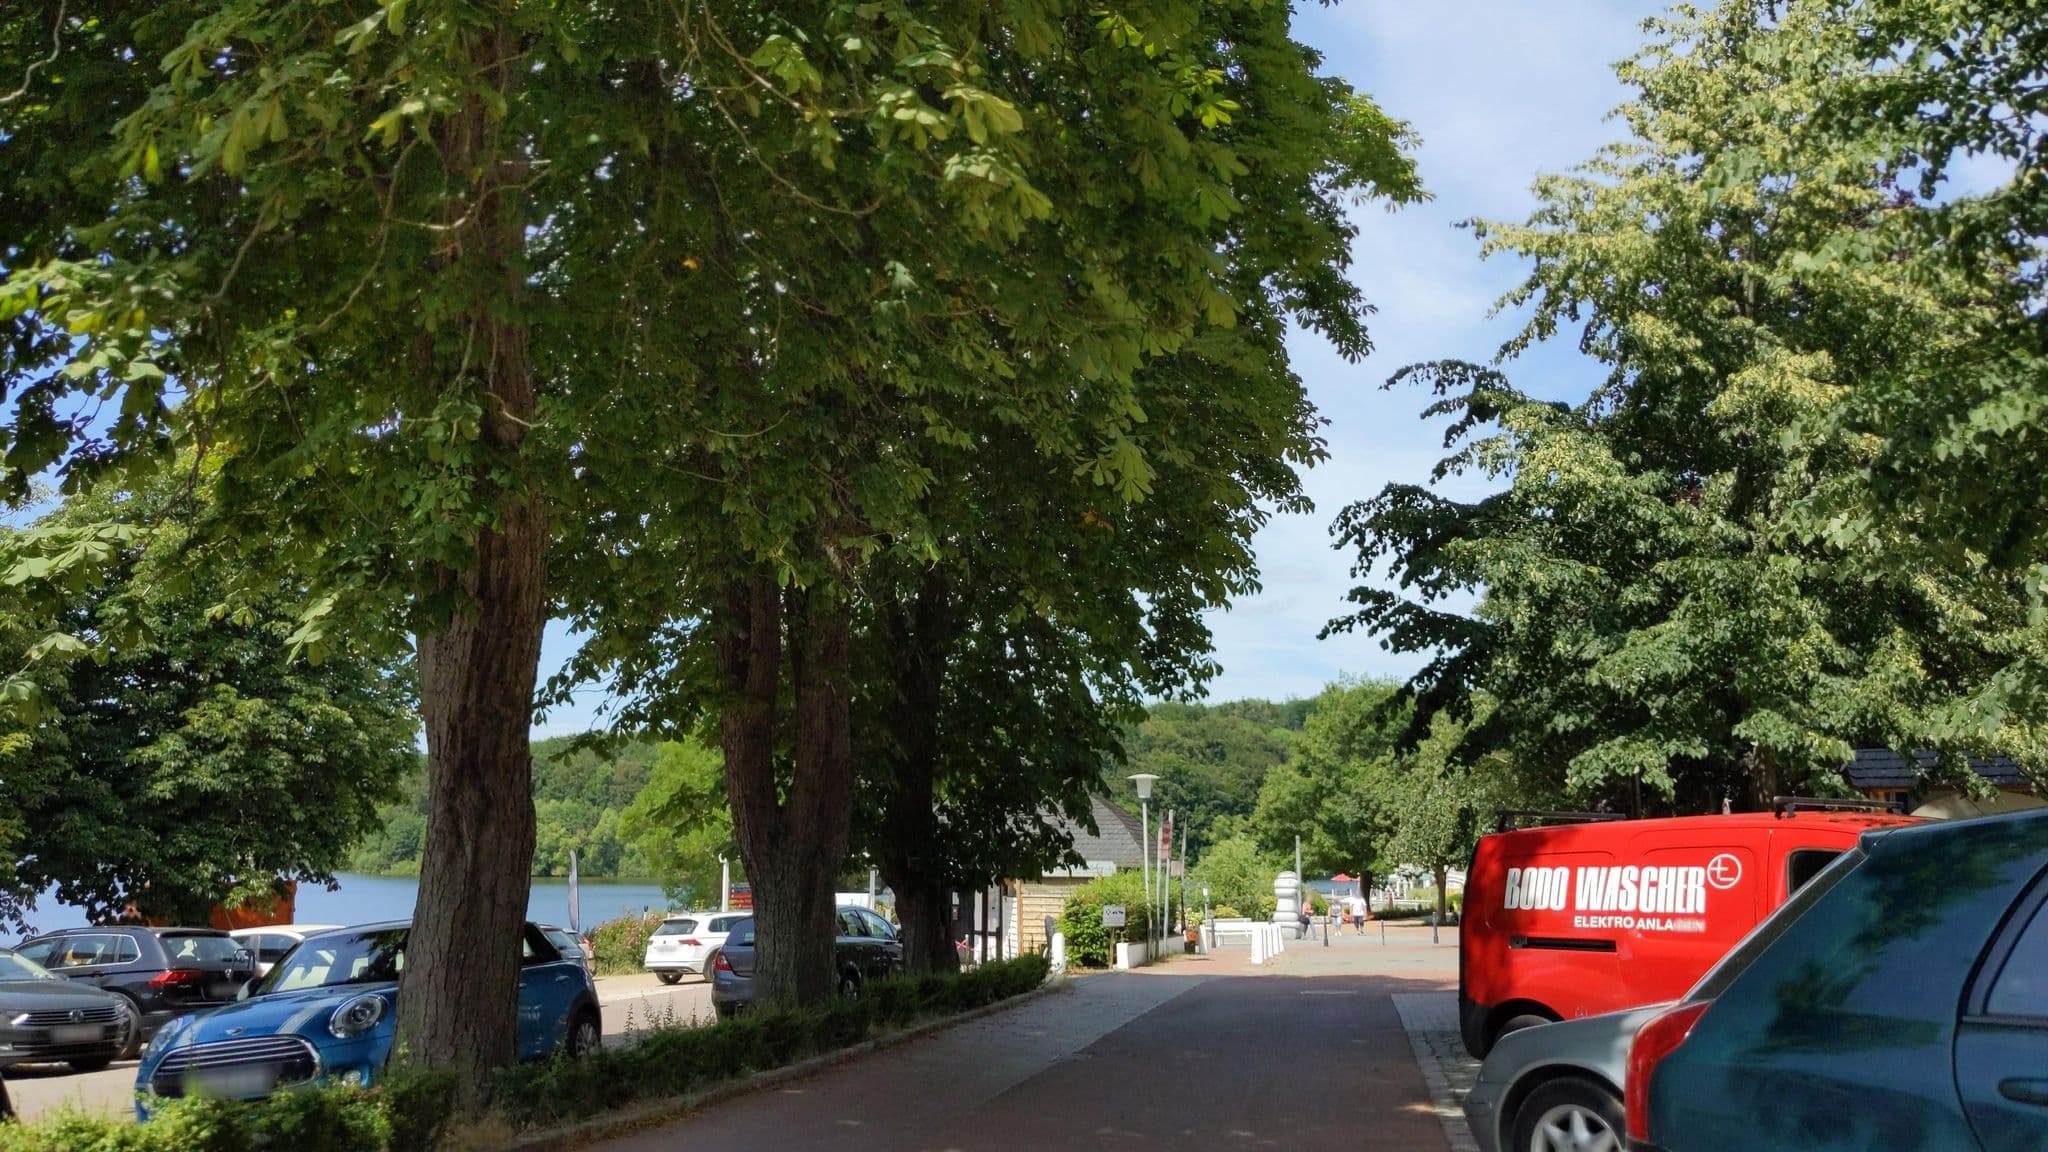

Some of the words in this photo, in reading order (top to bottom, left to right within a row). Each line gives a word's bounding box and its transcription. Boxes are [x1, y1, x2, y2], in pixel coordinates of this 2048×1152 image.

[1504, 867, 1569, 910] BODO
[1575, 866, 1706, 913] WASCHER
[1574, 916, 1634, 929] ELEKTRO
[1636, 918, 1705, 932] ANLAN
